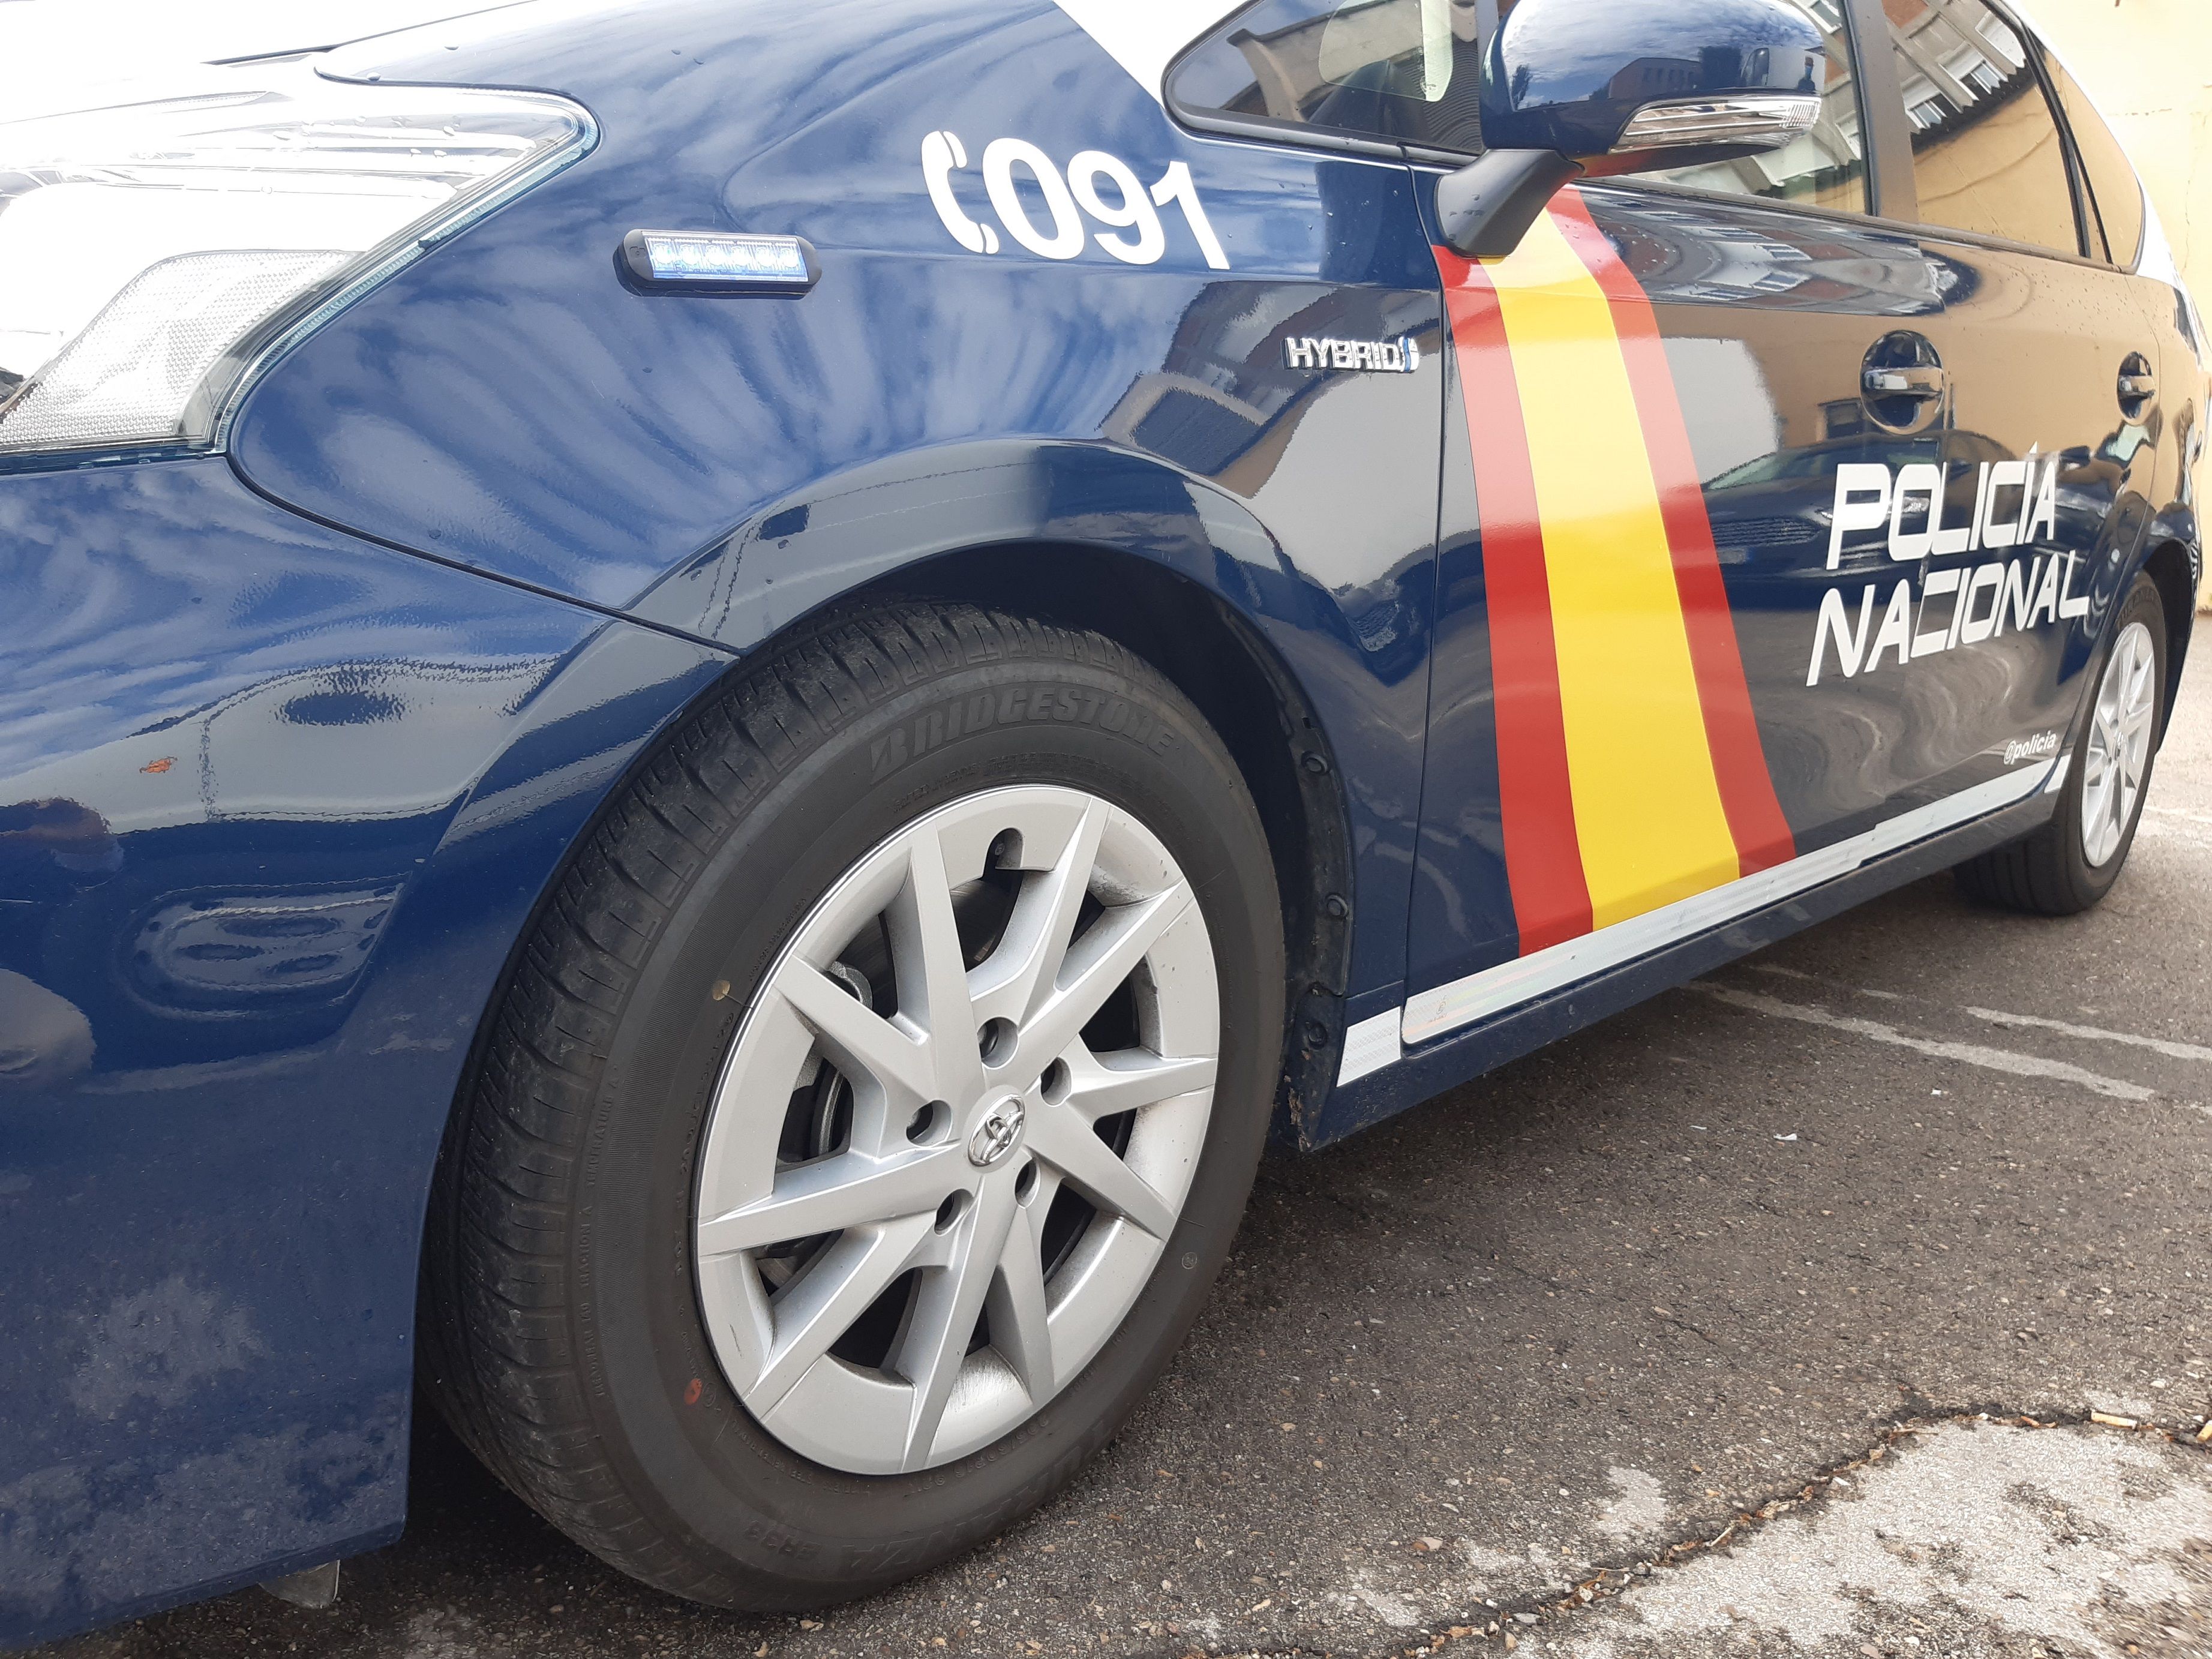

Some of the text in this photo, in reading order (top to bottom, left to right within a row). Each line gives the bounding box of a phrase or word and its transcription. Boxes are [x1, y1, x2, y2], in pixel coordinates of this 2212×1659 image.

[982, 137, 1230, 270] 091
[1283, 337, 1404, 371] HYBRID
[1826, 442, 2056, 571] POLICÍA
[1806, 550, 2090, 687] NACIONAL
[870, 688, 1178, 773] BRIDGESTONE
[2003, 730, 2058, 766] @policia
